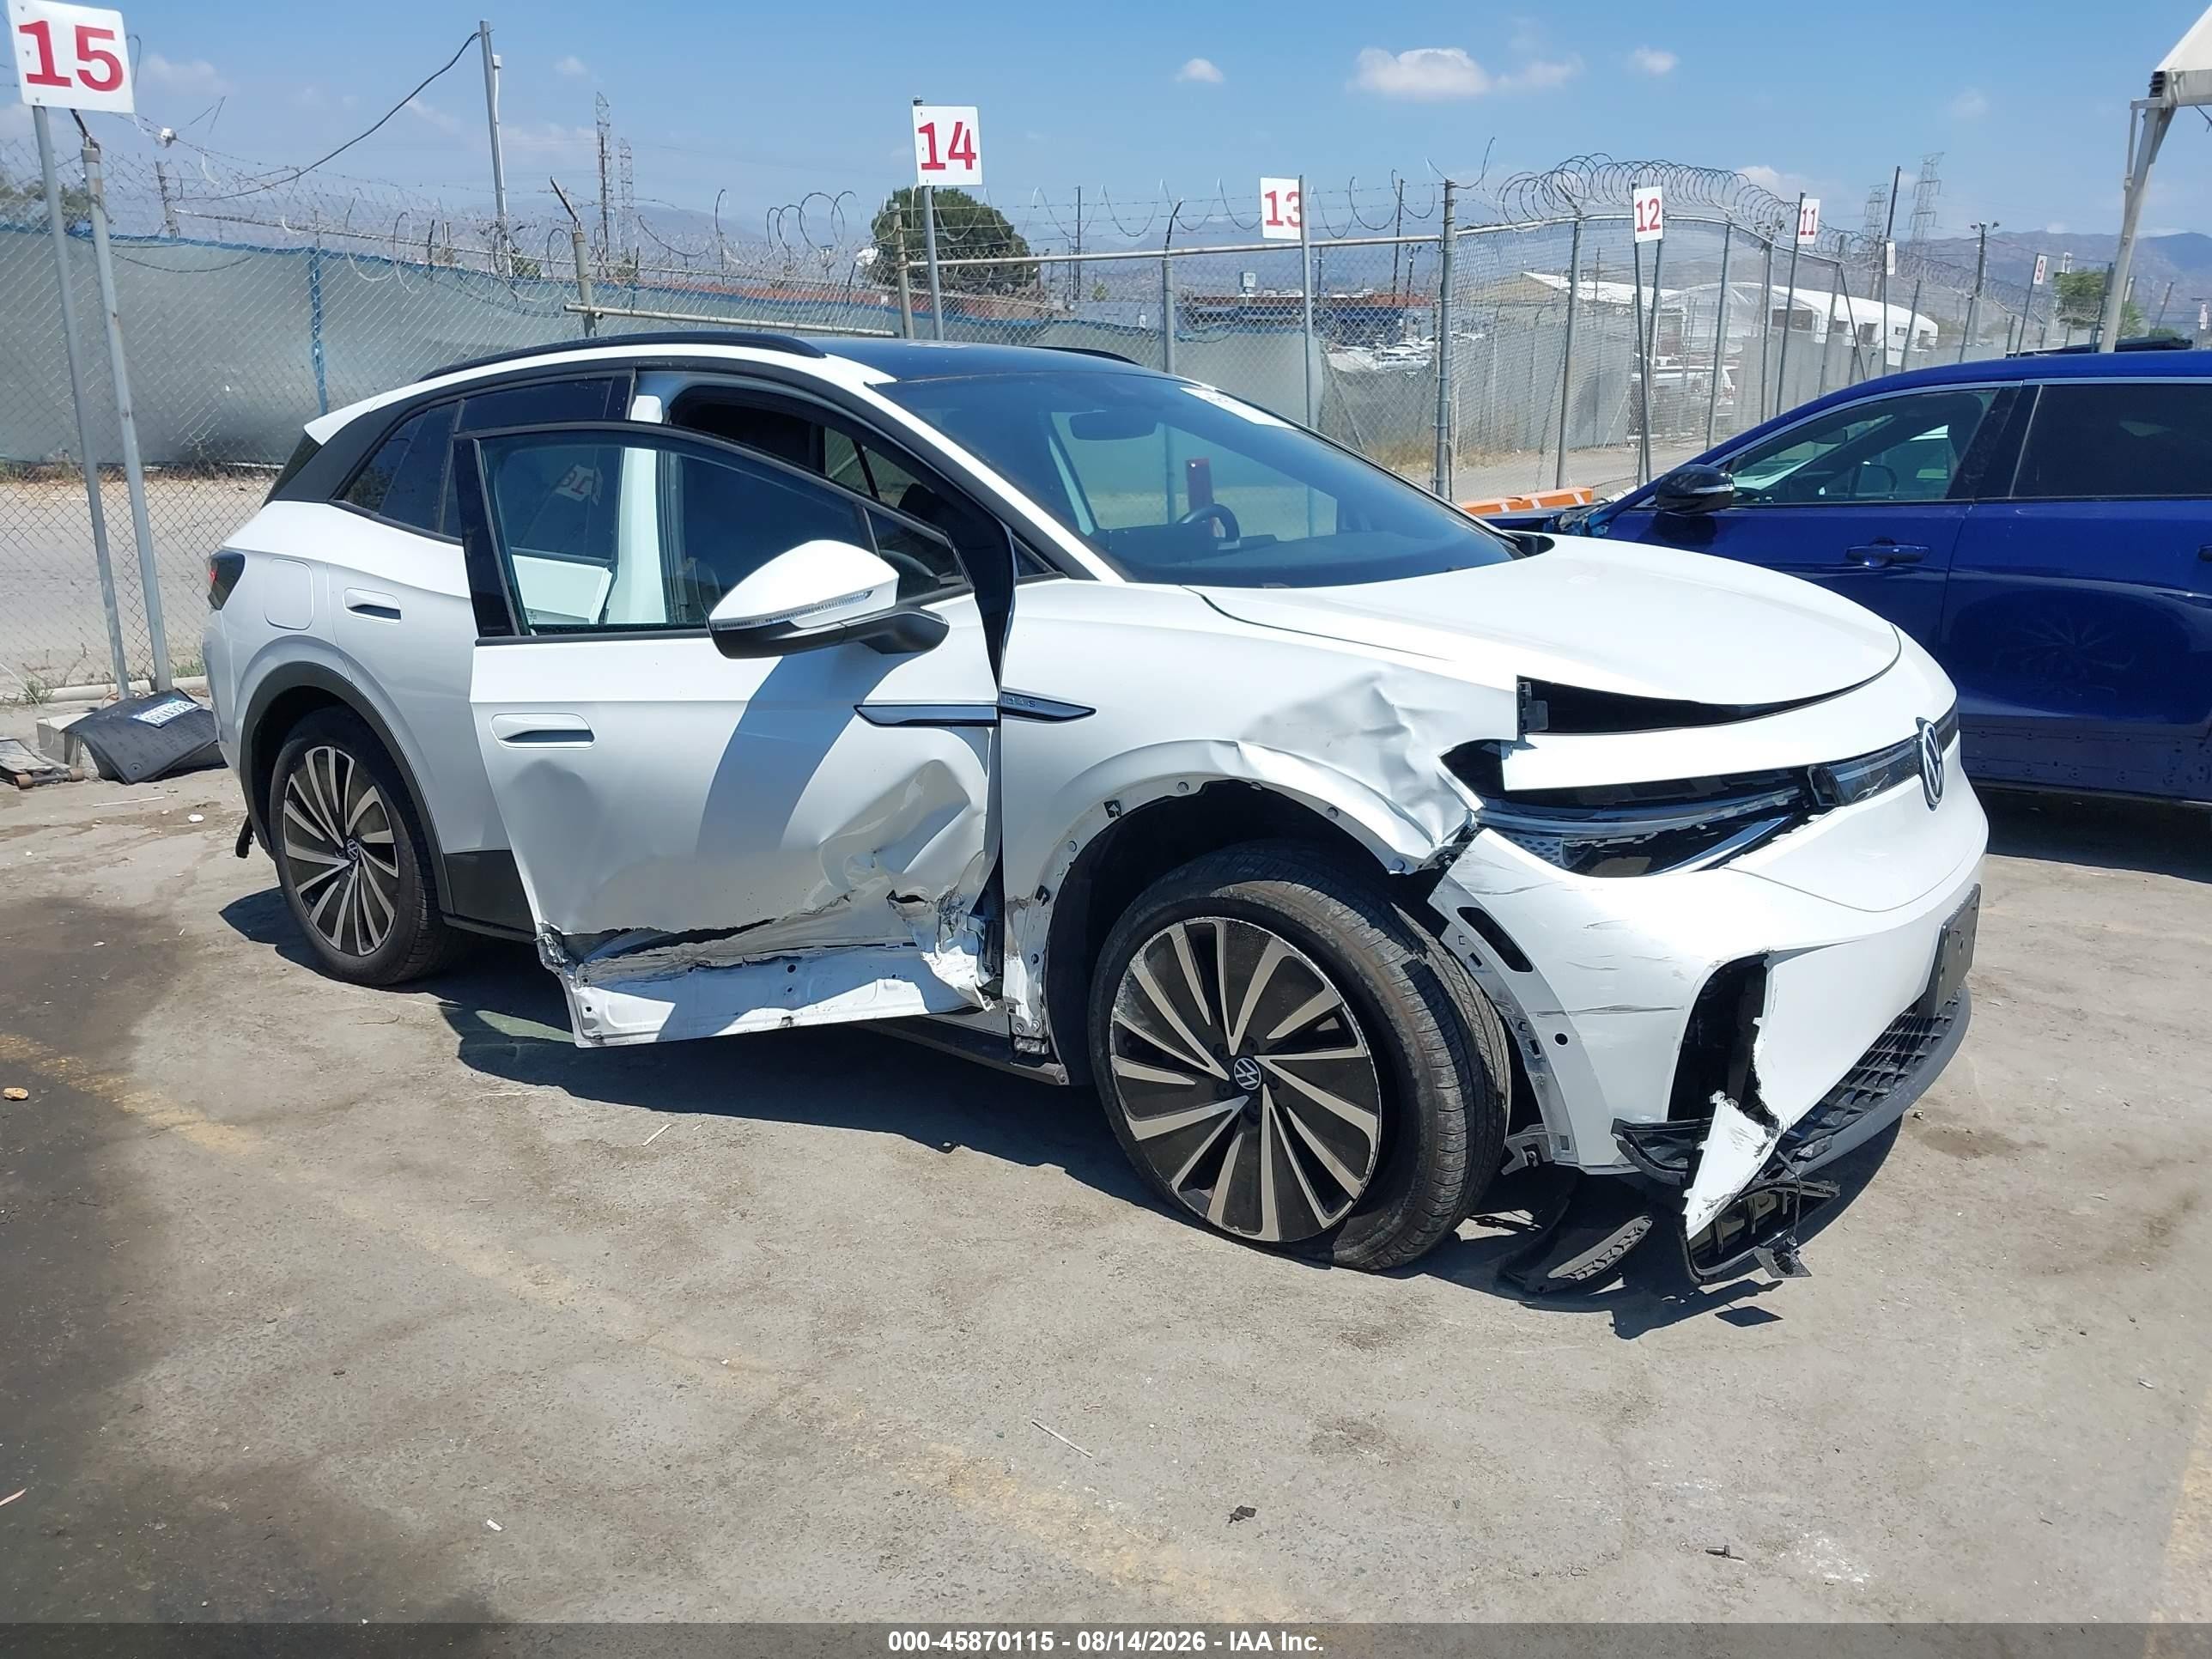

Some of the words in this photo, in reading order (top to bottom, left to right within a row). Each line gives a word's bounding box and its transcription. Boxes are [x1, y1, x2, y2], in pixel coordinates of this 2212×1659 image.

[19, 21, 124, 92] 15
[918, 121, 977, 171] 14
[1264, 190, 1301, 228] 13
[1636, 198, 1661, 233] 12
[1800, 207, 1816, 236] 11
[2036, 259, 2044, 281] 9
[1234, 1058, 1261, 1090] VW
